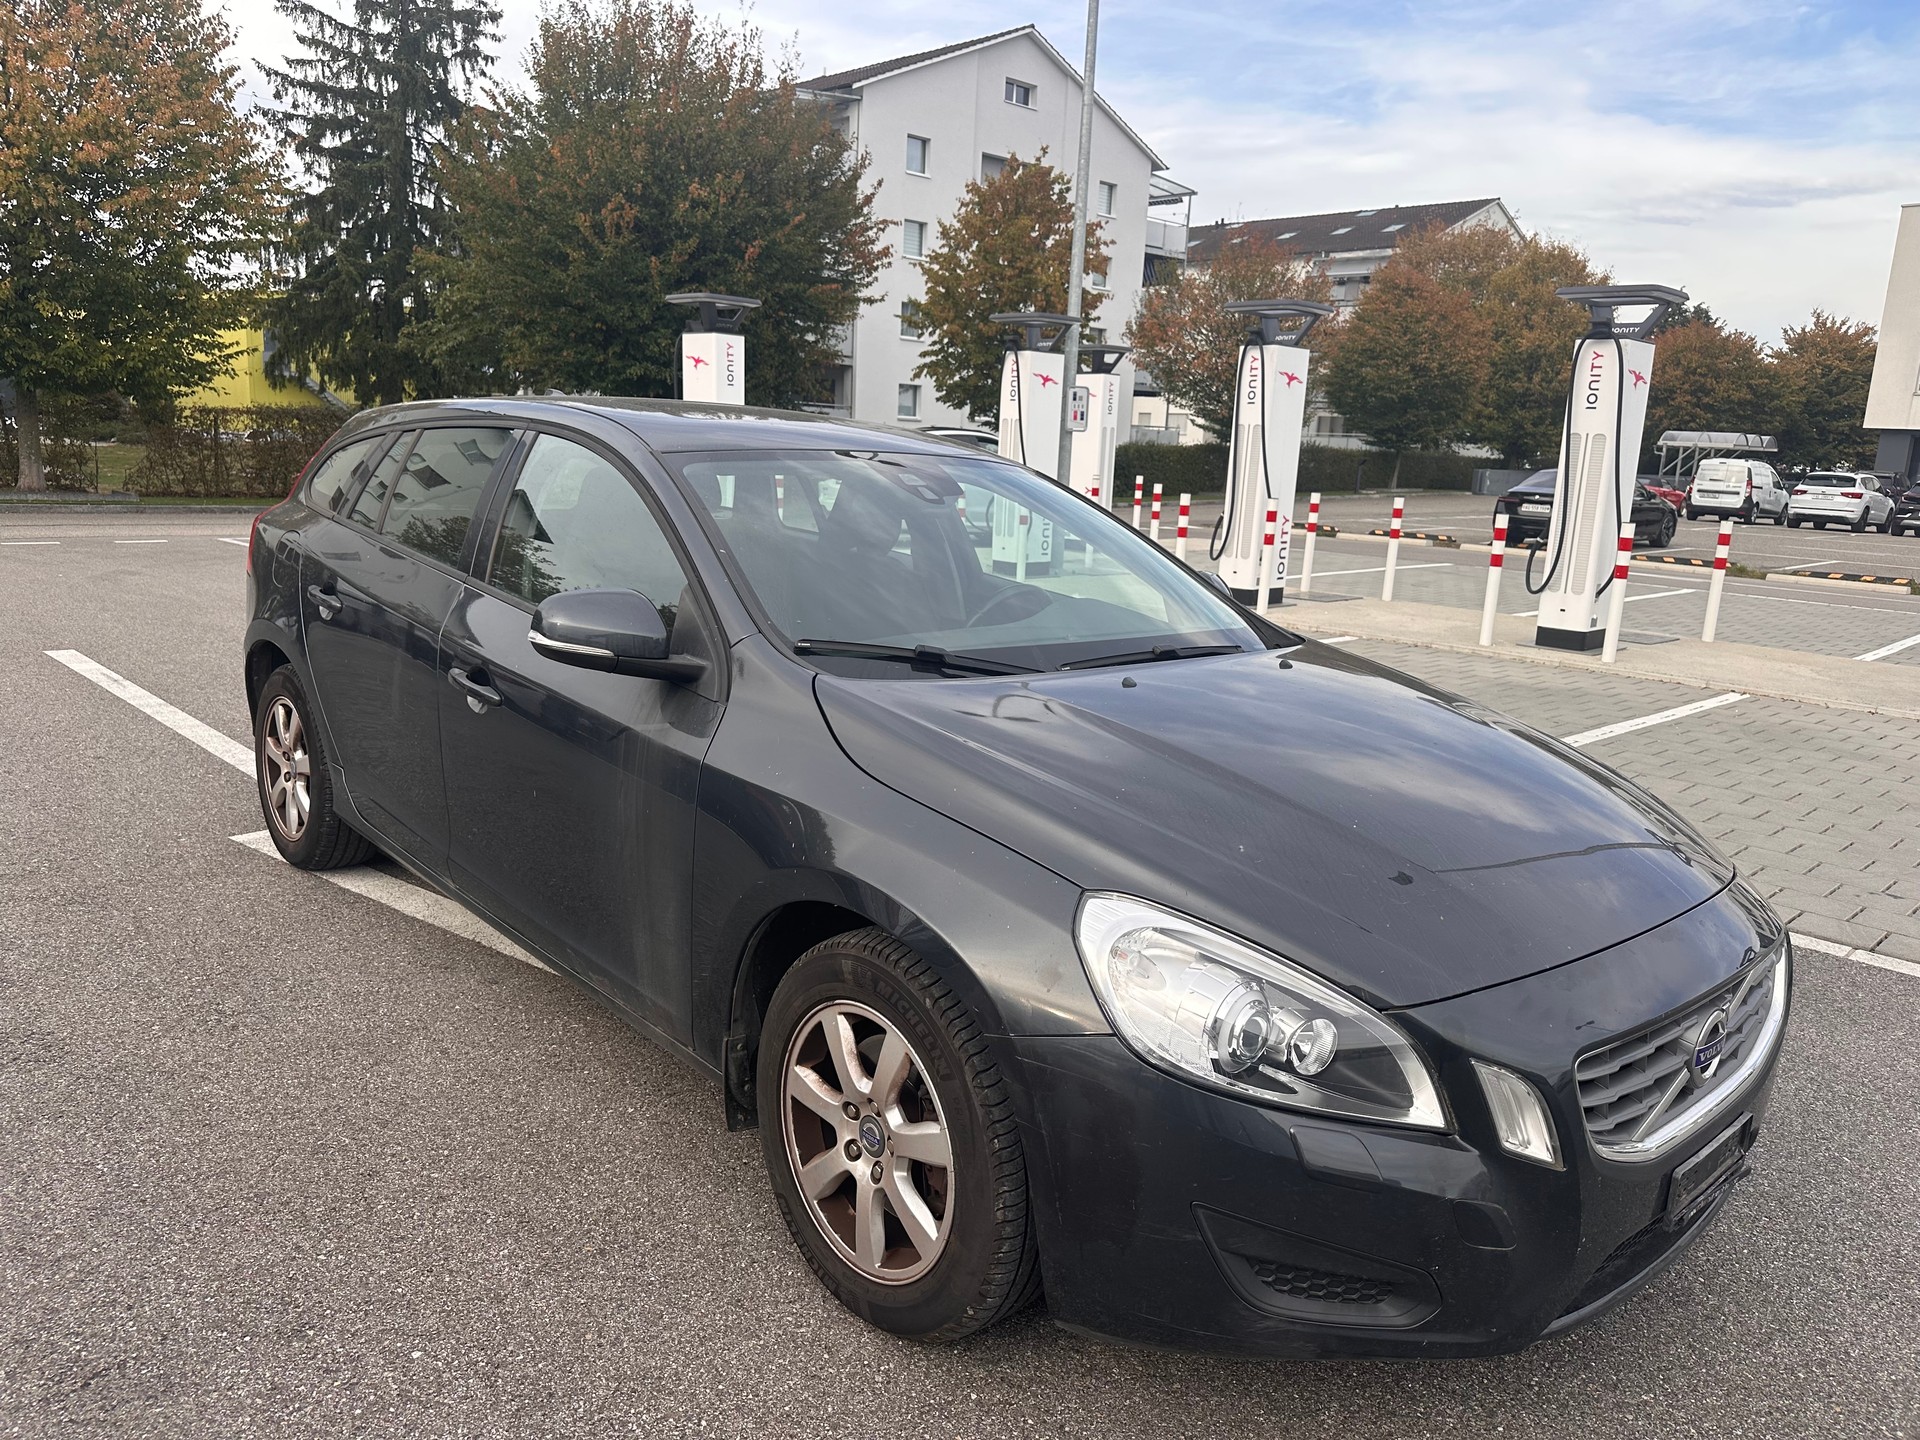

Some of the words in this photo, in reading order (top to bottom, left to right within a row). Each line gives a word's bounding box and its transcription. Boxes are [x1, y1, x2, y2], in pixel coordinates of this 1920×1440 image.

[726, 342, 734, 386] IONITY
[1010, 358, 1018, 402] IONITY
[1246, 355, 1259, 405] IONITY
[1584, 351, 1605, 410] IONITY
[1041, 518, 1051, 556] IONI
[1276, 515, 1290, 581] IONITY
